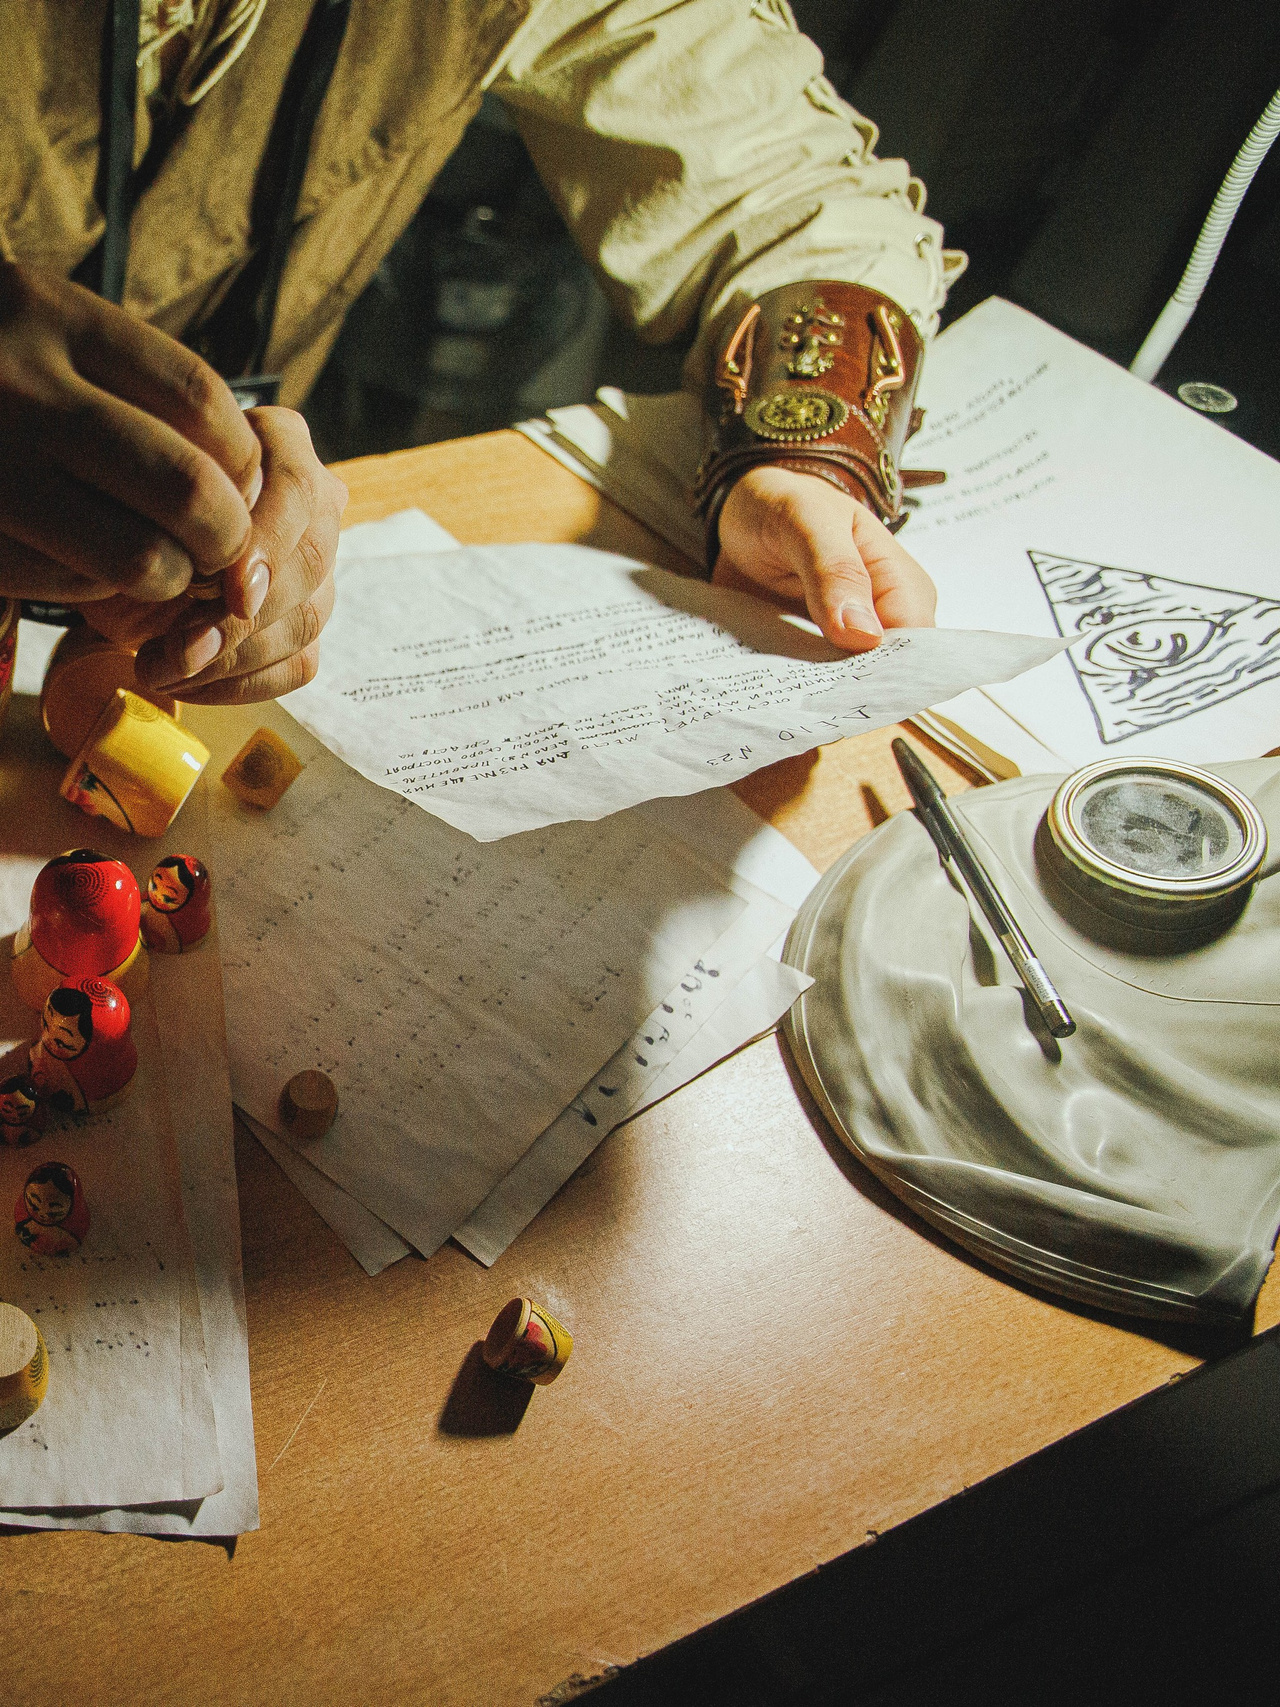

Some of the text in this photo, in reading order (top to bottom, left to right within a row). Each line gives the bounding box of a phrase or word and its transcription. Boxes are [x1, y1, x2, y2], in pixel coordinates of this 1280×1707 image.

[461, 747, 501, 759] СКОРО
[535, 740, 567, 754] ДЕЛО
[536, 751, 570, 766] ДЛЯ
[384, 758, 451, 775] ПОСТРОЯТ
[404, 764, 528, 793] РАЗМЕЩЕНИЯ
